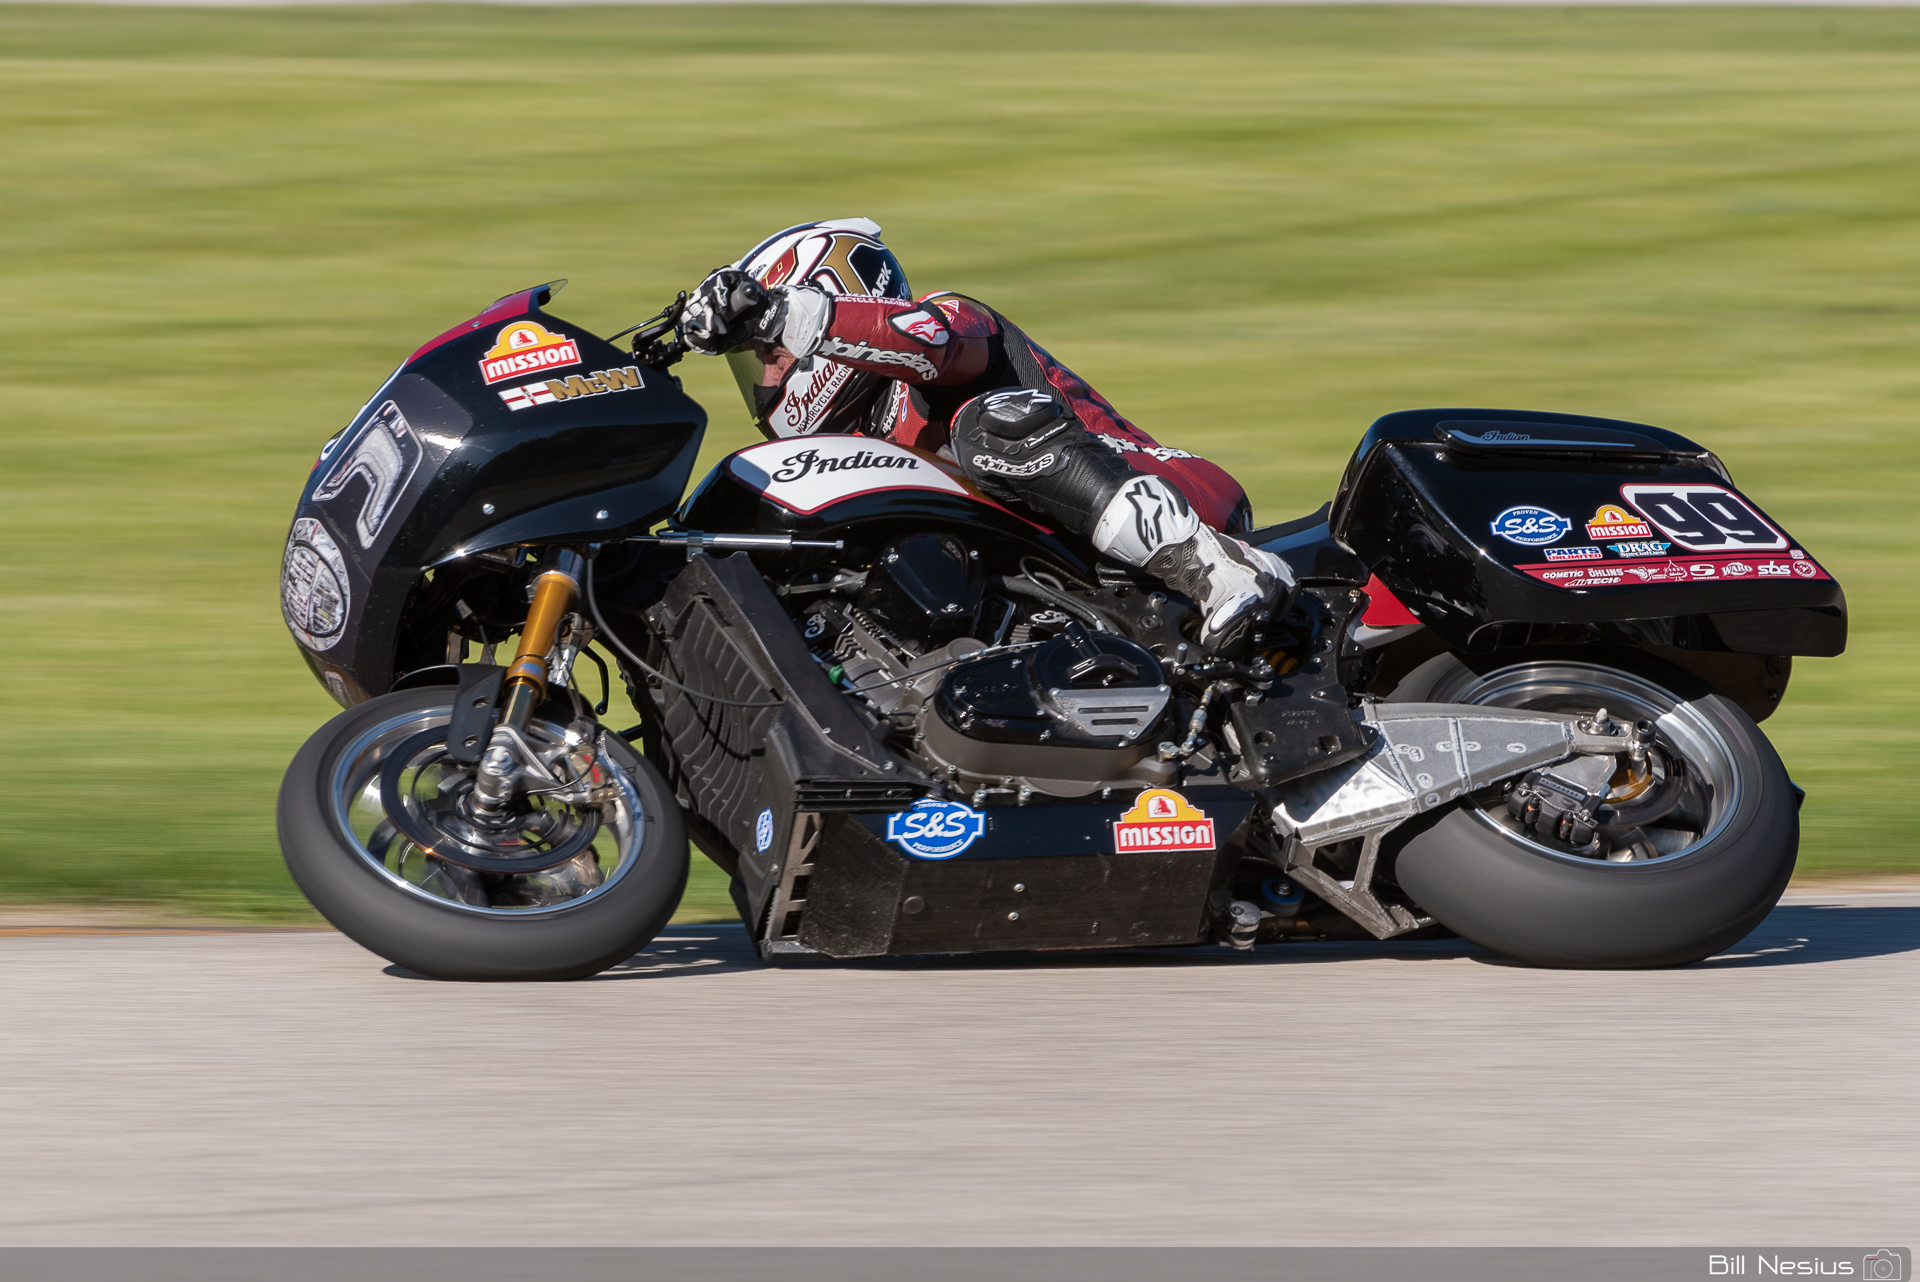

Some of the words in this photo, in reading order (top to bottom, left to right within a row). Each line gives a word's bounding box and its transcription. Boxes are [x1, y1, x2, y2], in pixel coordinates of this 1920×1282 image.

[486, 345, 575, 379] MISSION
[820, 336, 939, 381] lpinestars
[1480, 429, 1531, 441] Indian
[771, 449, 920, 483] Indian
[973, 453, 1055, 477] alpinestars
[1505, 516, 1556, 535] S&S
[1634, 492, 1779, 546] 99
[1591, 525, 1648, 537] MISSION
[1545, 547, 1600, 556] PARTS
[1617, 541, 1662, 553] DRAG
[1757, 560, 1791, 575] sbs
[902, 811, 968, 839] S&S
[1119, 823, 1212, 846] MISSION
